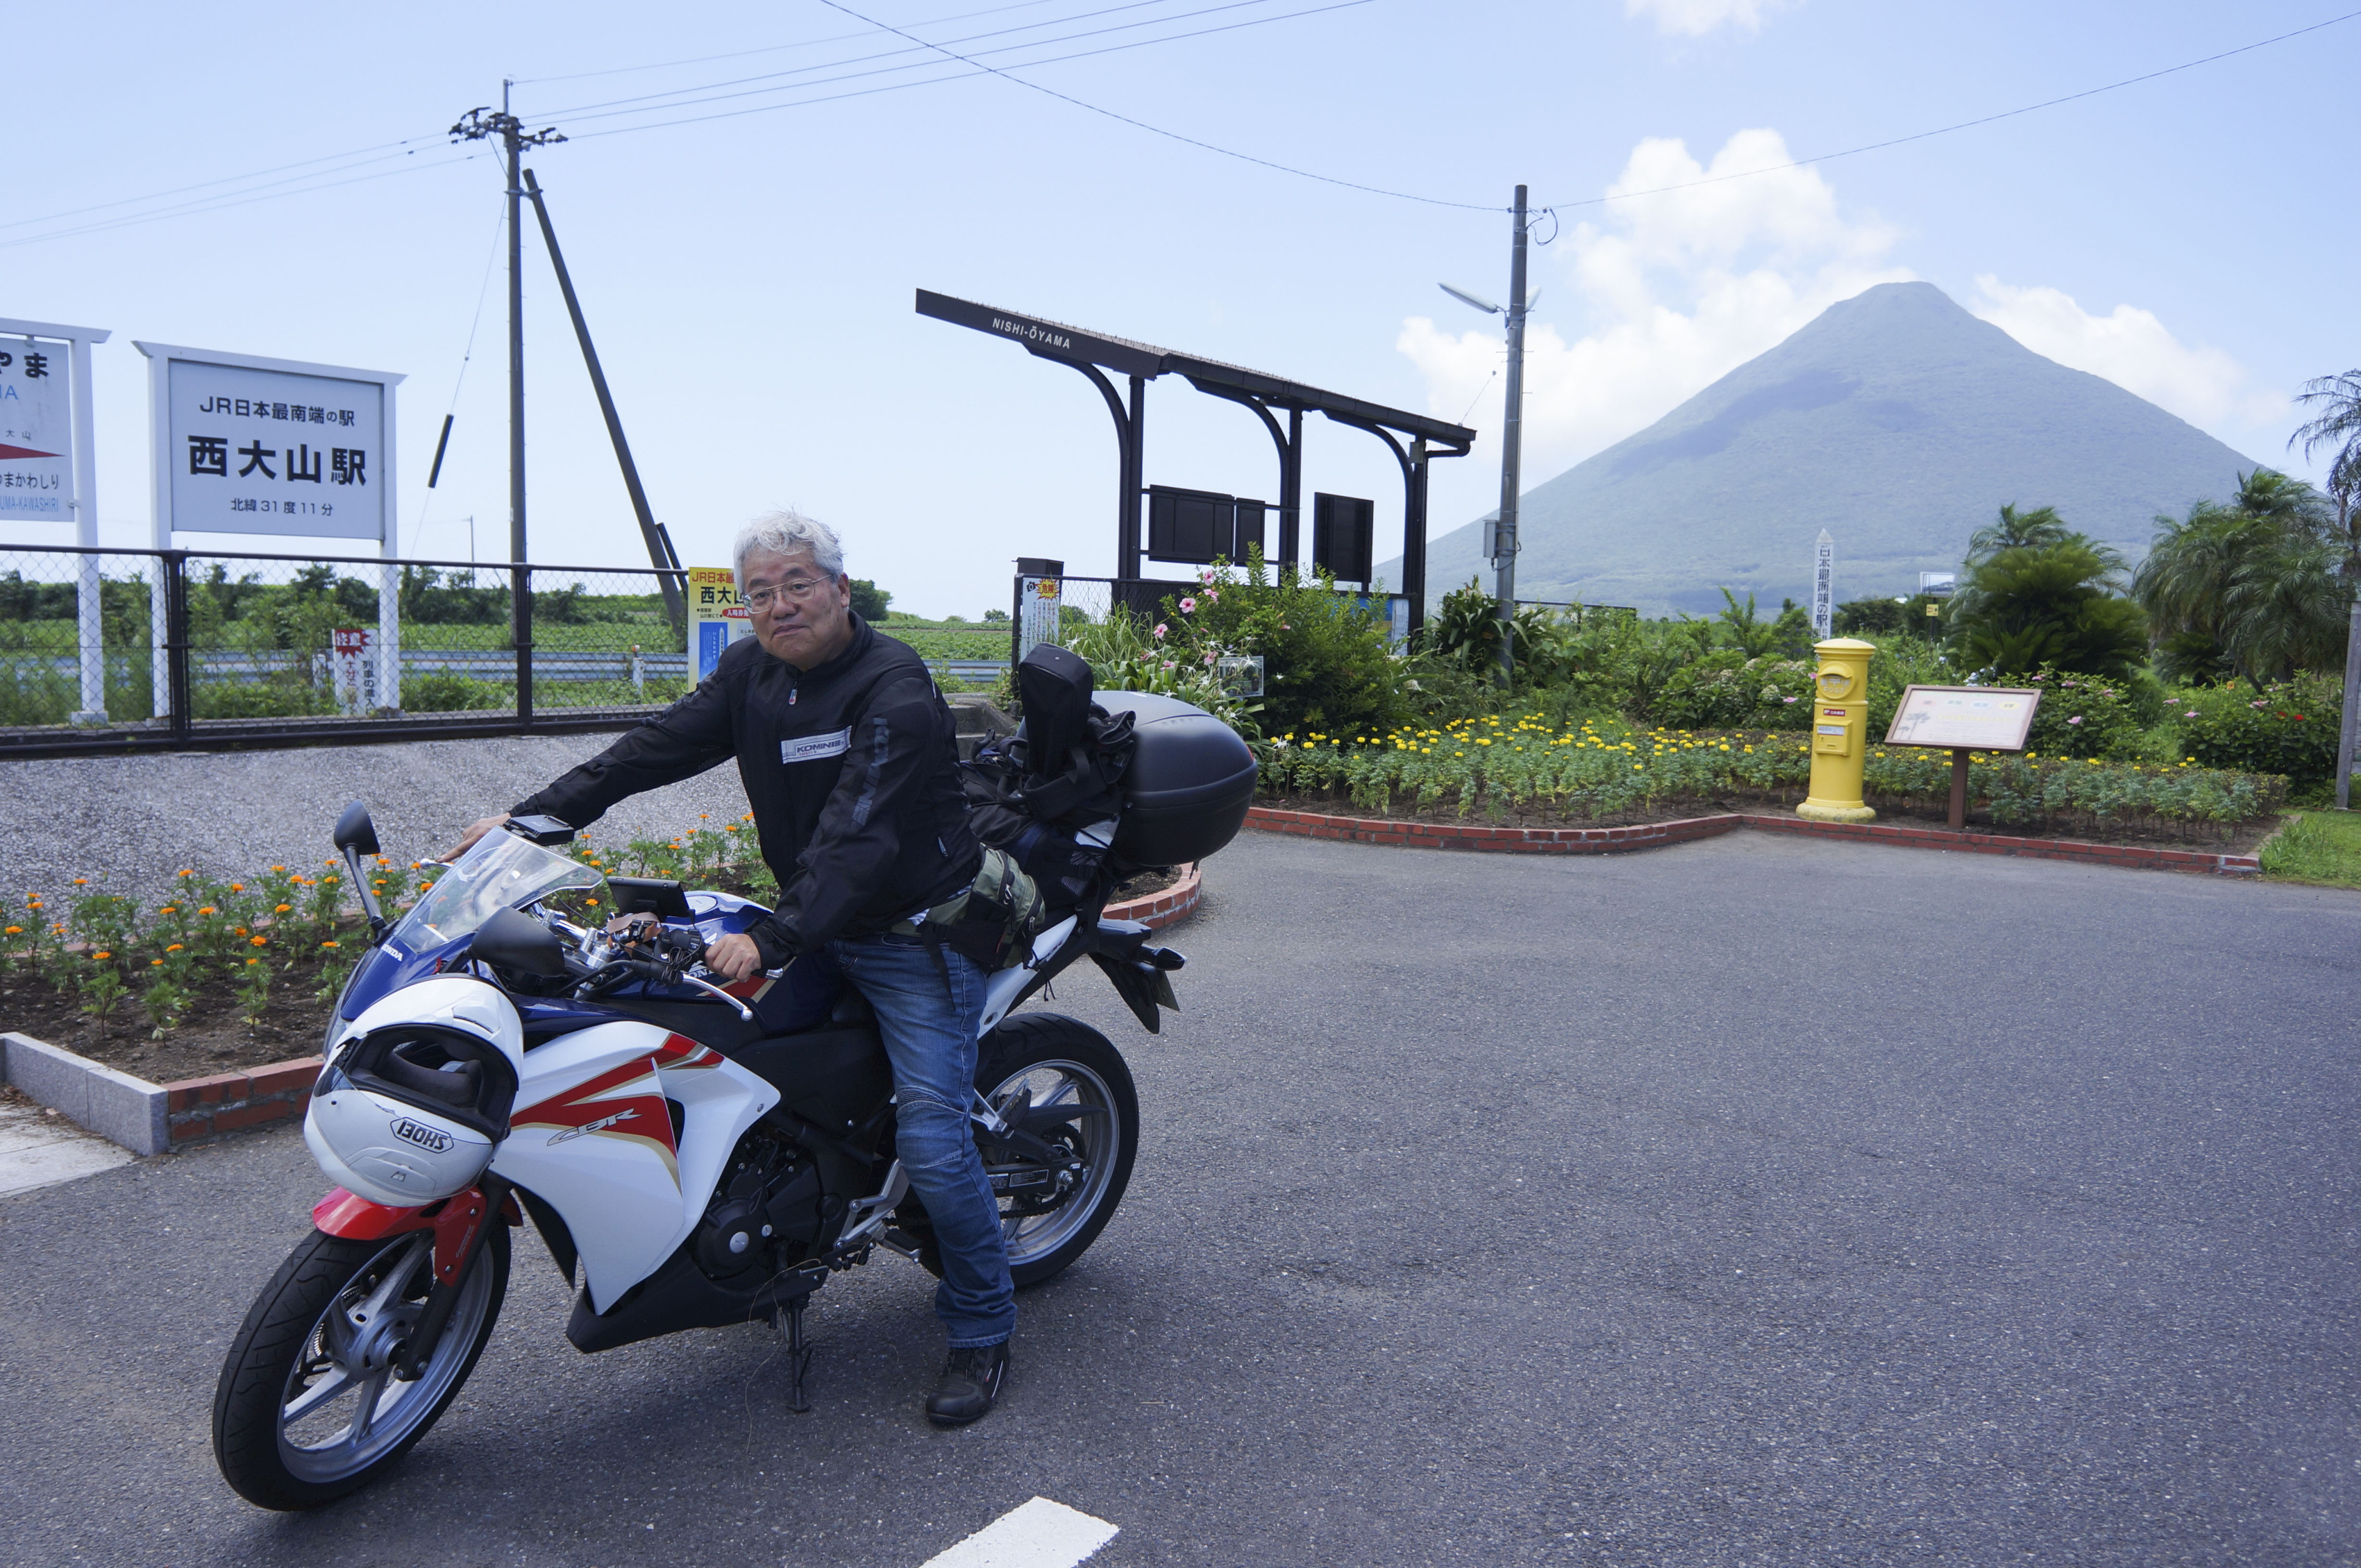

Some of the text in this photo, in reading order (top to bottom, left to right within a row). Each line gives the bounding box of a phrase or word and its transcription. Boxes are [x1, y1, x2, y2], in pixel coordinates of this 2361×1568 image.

[199, 396, 355, 427] JR日本最南端の駅
[188, 435, 366, 486] 西大山駅
[0, 472, 59, 490] まかわしり
[230, 497, 333, 516] 北緯31度11分
[397, 1121, 448, 1150] SHOEI
[547, 1108, 643, 1147] CBR
